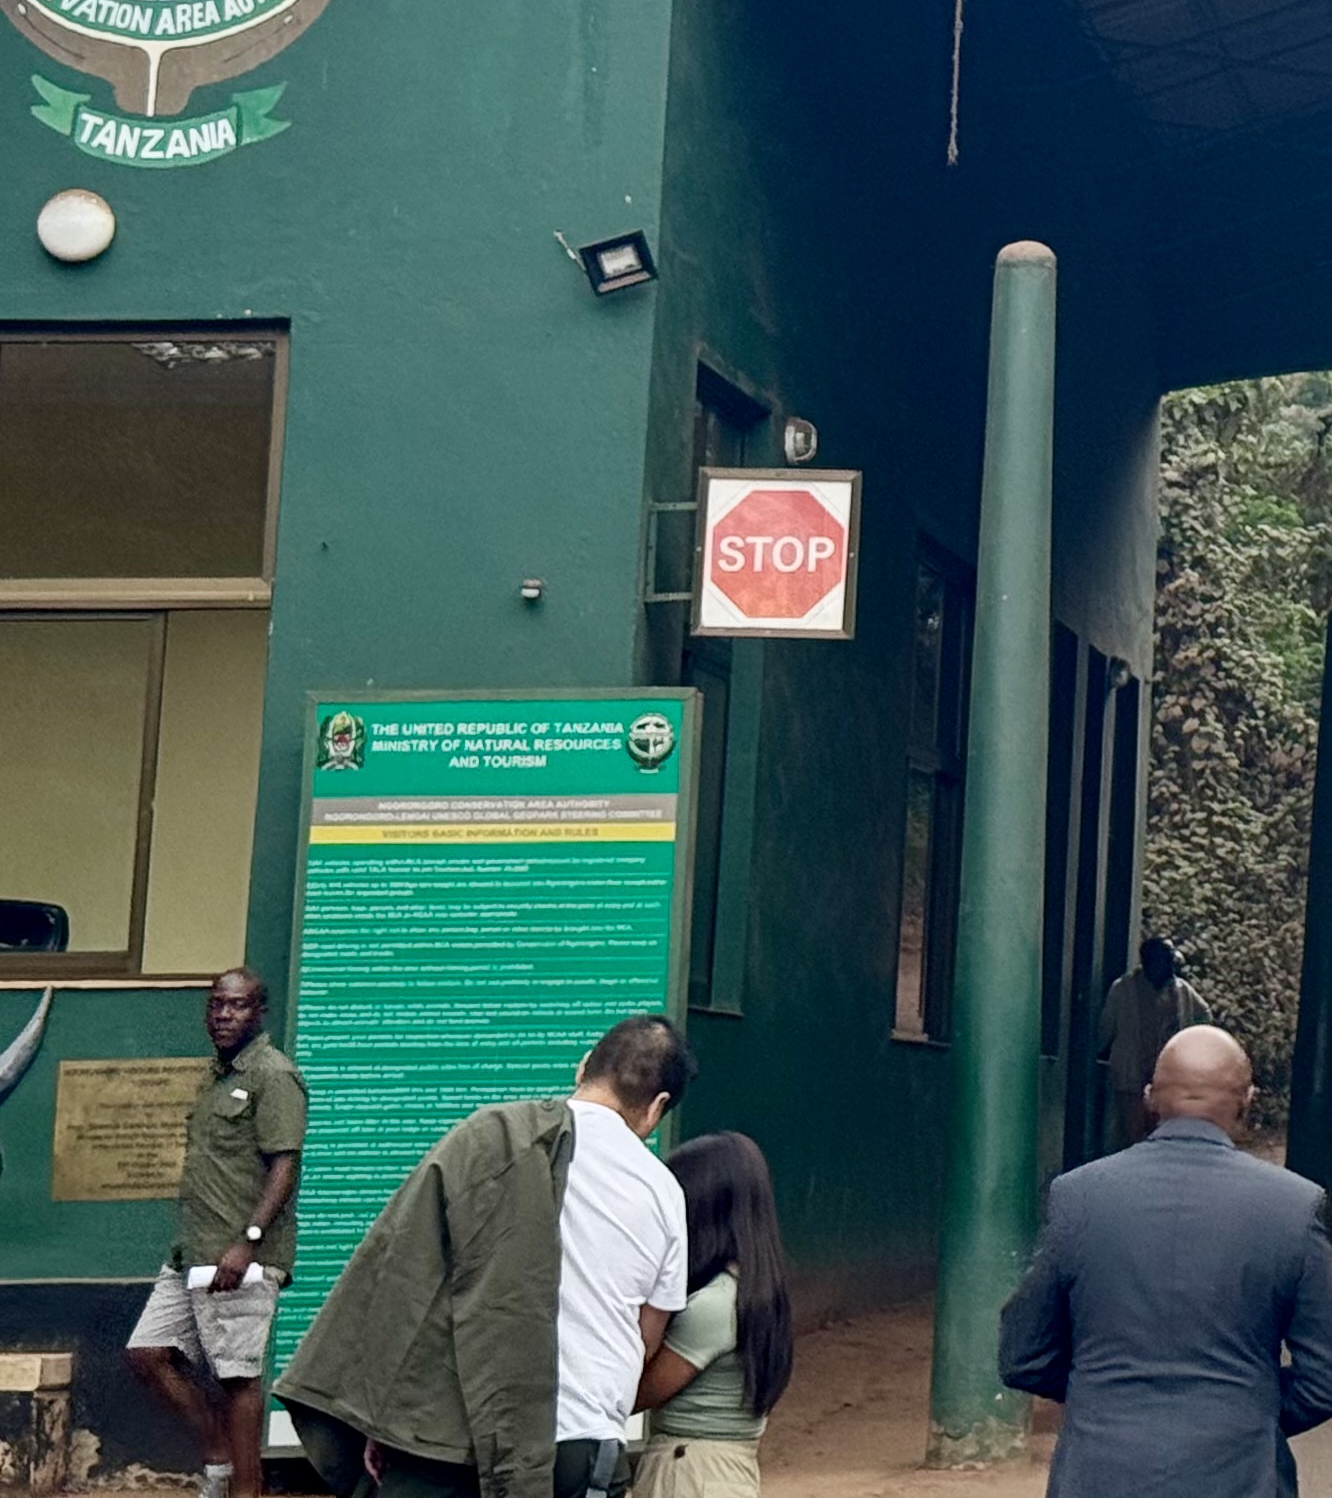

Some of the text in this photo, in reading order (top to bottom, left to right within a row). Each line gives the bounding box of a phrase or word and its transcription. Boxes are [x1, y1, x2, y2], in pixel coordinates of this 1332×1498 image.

[79, 113, 237, 159] TANZANIA
[717, 536, 836, 573] STOP
[371, 722, 624, 736] THE UNITED REPUBLIC OF TANZANIA
[371, 738, 622, 752] MINISTRY OF NATURAL RESOURCES
[448, 755, 547, 768] AND TOURISM
[527, 800, 554, 810] AREA
[555, 800, 611, 809] AUTHORITY
